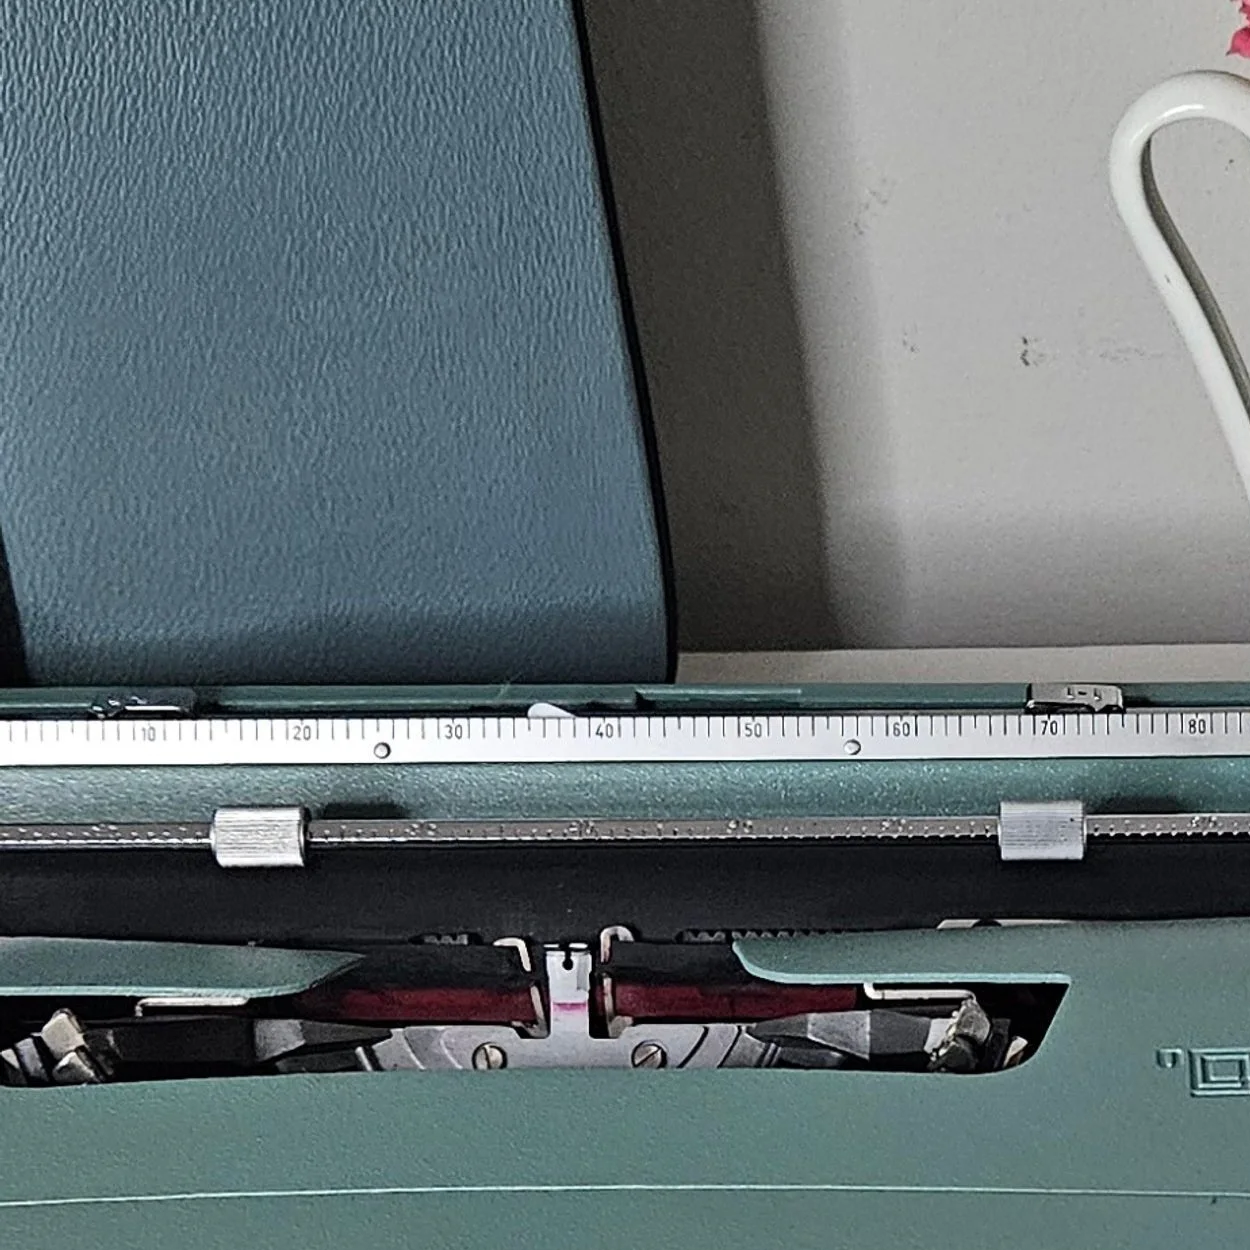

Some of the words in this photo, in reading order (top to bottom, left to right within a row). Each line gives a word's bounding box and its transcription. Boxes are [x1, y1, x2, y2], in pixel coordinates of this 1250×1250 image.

[141, 725, 156, 743] 10
[293, 725, 313, 742] 20
[444, 723, 464, 740] 30
[595, 722, 614, 739] 40
[744, 721, 763, 738] 50
[892, 720, 911, 737] 60
[1040, 720, 1058, 736] 70
[1188, 719, 1207, 735] 80
